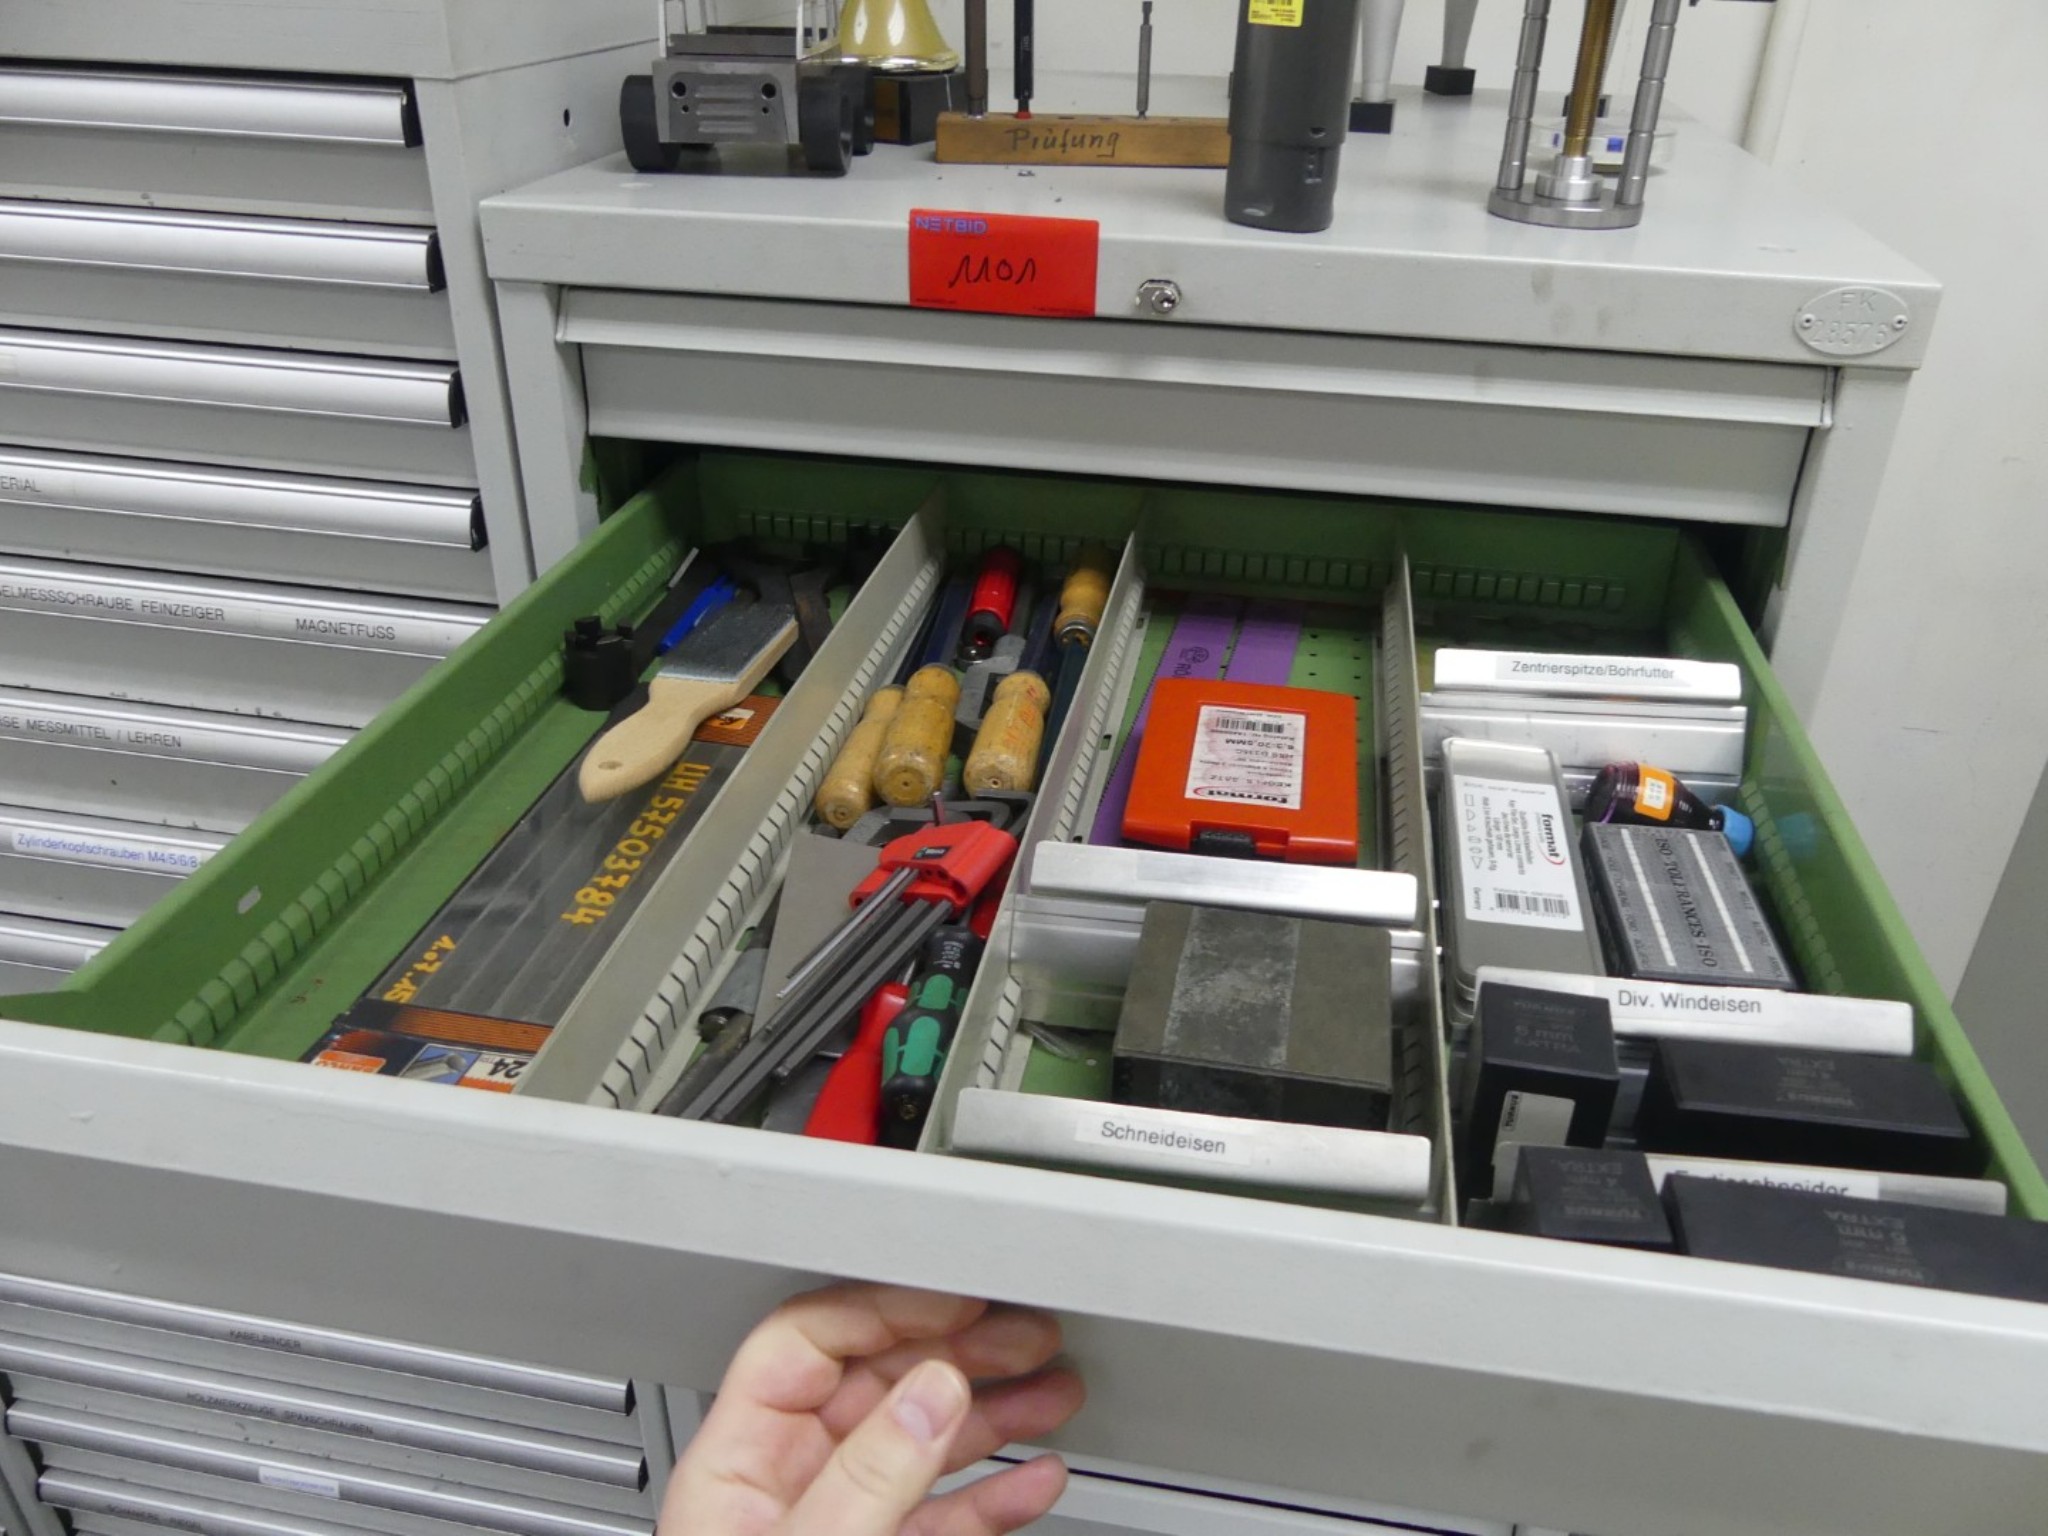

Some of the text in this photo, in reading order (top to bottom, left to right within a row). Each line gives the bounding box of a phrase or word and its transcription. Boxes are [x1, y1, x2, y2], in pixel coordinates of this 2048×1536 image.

[1004, 127, 1120, 158] Prüfung
[914, 216, 987, 234] NETBID
[0, 585, 225, 622] ELMESSSCHRAUBE FEINZEIGER
[295, 618, 396, 641] MAGNETFUSS
[0, 715, 20, 729] SE
[26, 718, 111, 741] MESSMITTEL
[127, 731, 182, 748] LEHREN
[18, 832, 144, 861] Zylinderkopfschrauben
[1541, 813, 1560, 858] format
[1618, 989, 1762, 1014] Div. Windeisen
[1101, 1121, 1226, 1154] Schneideisen
